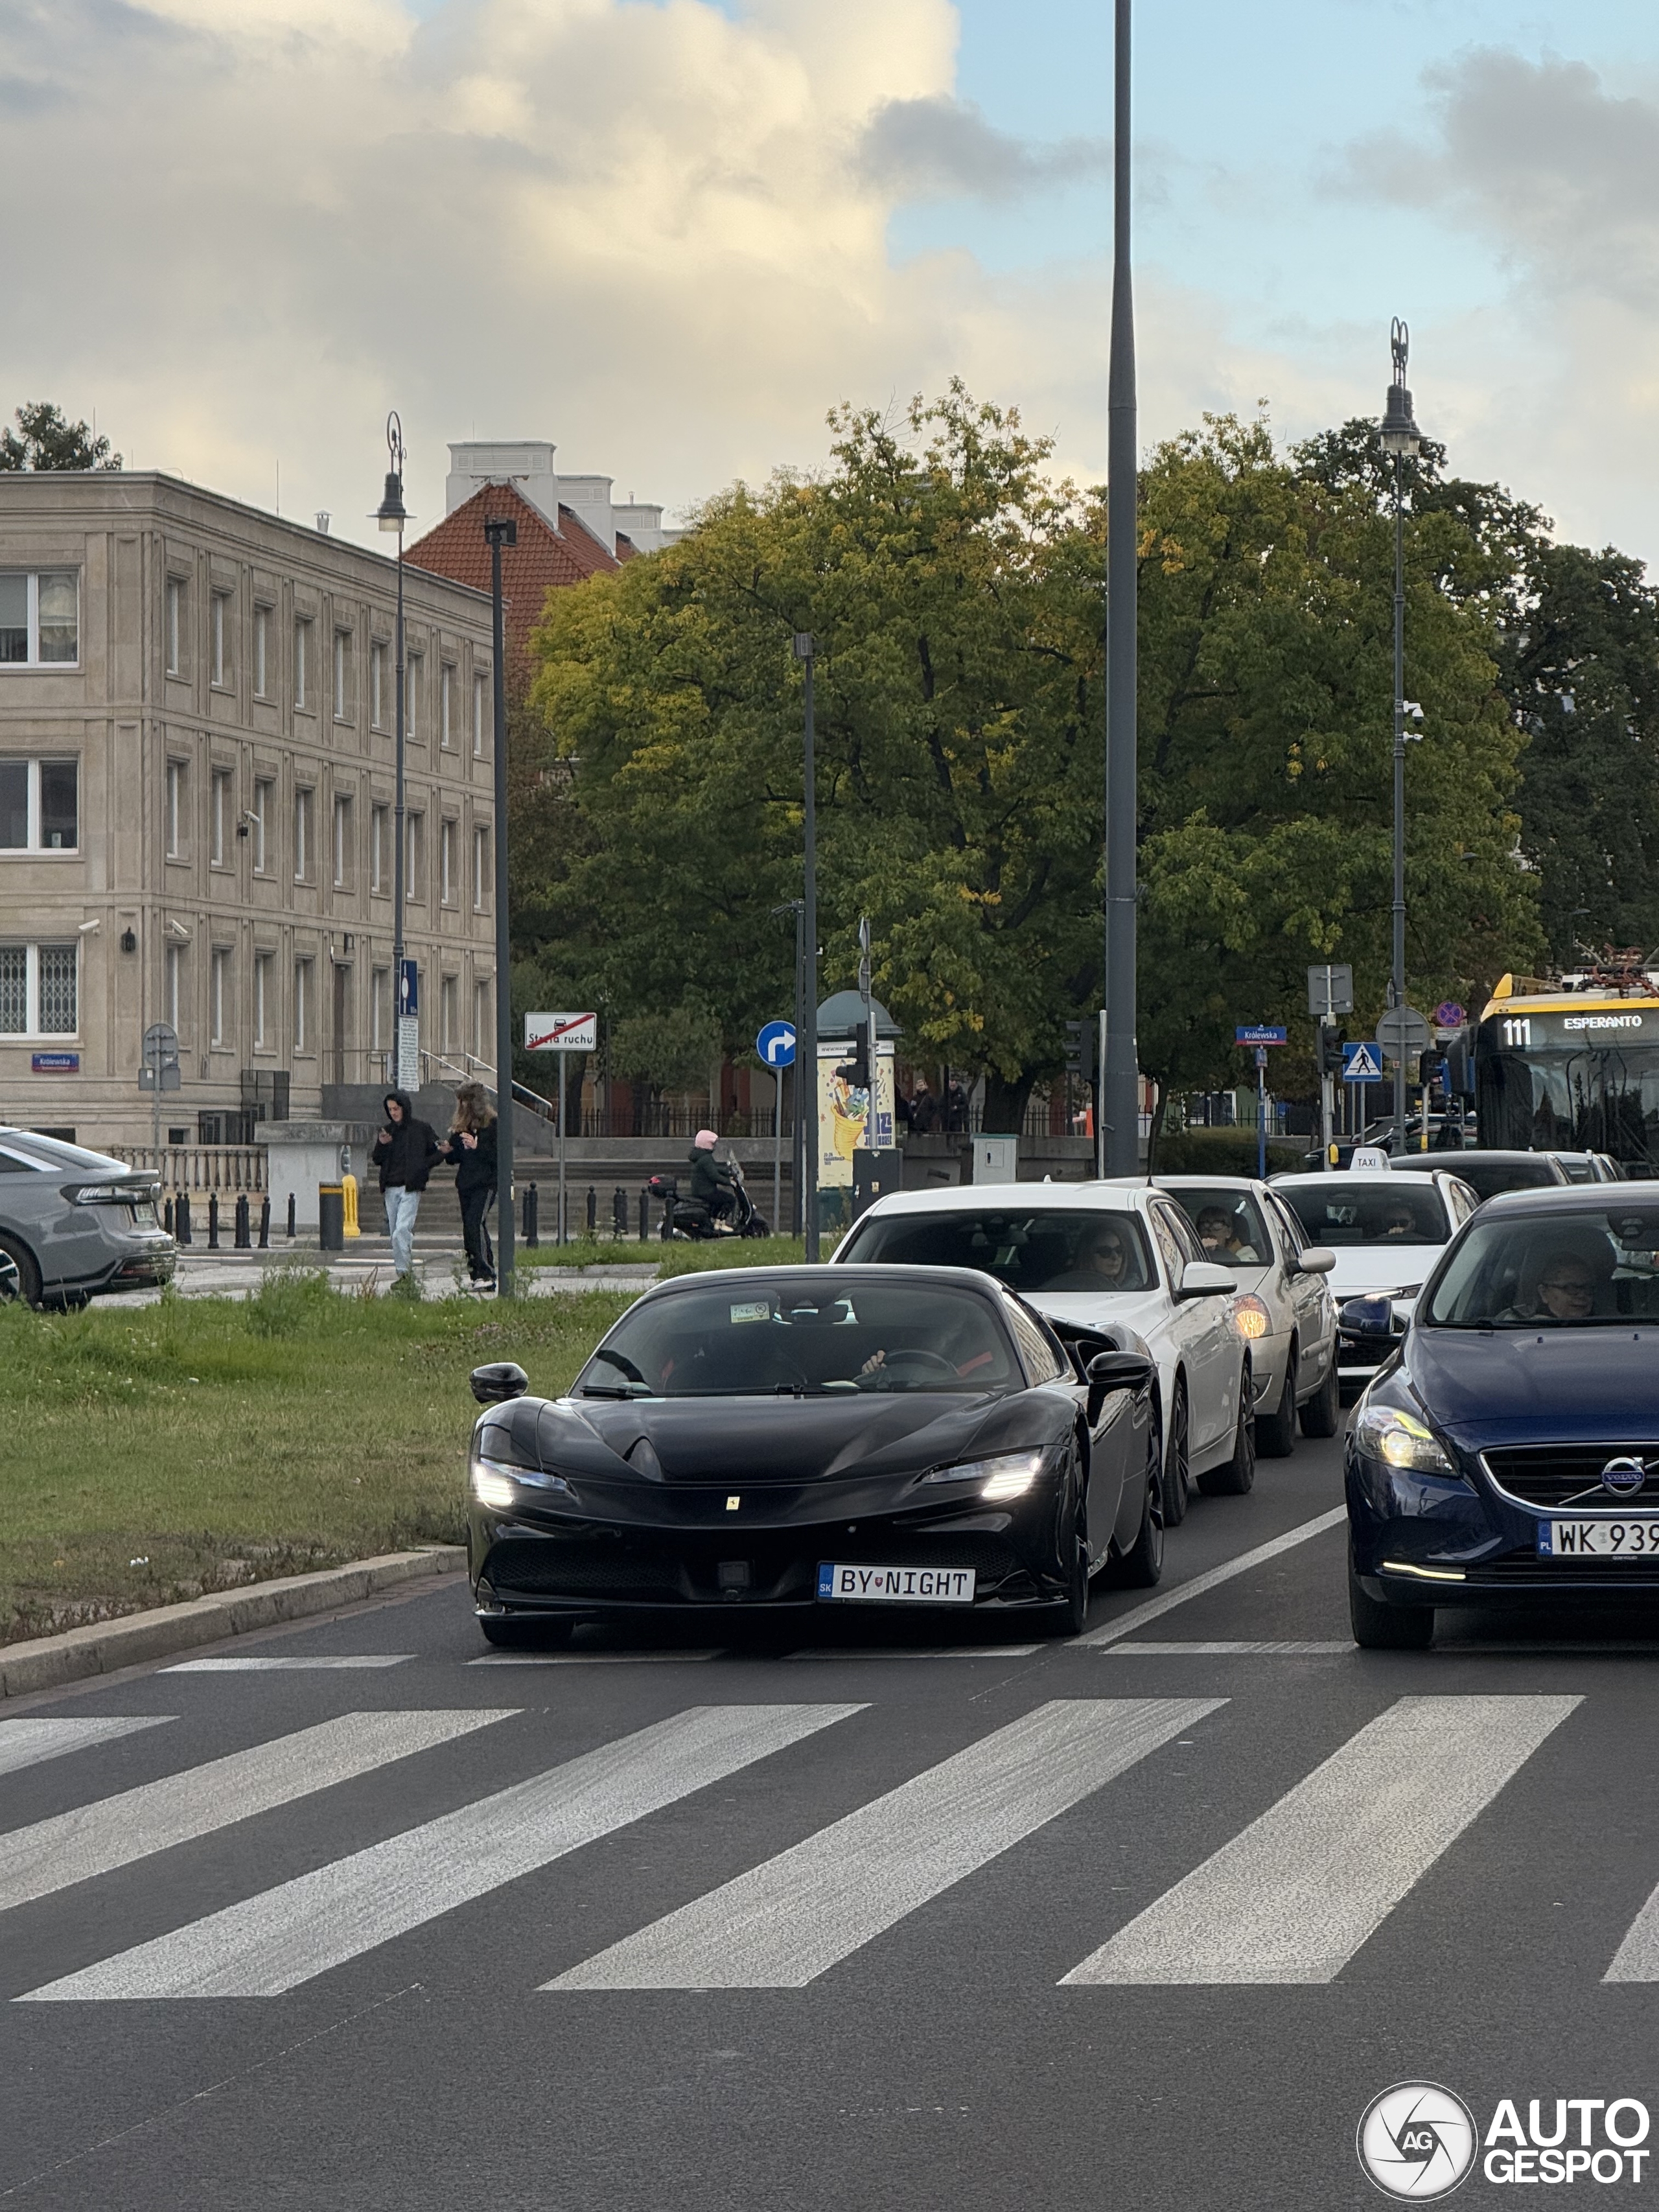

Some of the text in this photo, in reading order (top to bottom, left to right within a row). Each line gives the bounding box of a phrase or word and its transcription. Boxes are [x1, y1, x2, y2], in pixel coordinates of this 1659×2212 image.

[1245, 1030, 1277, 1039] Królewska
[1503, 1015, 1643, 1046] 111 ESPERANTO
[529, 1033, 593, 1043] Sta ruchu
[1357, 1158, 1376, 1167] TAXI
[1559, 1524, 1659, 1552] WK 939
[1540, 1541, 1551, 1550] PL
[841, 1569, 968, 1596] BY NIGHT
[820, 1583, 831, 1592] SK
